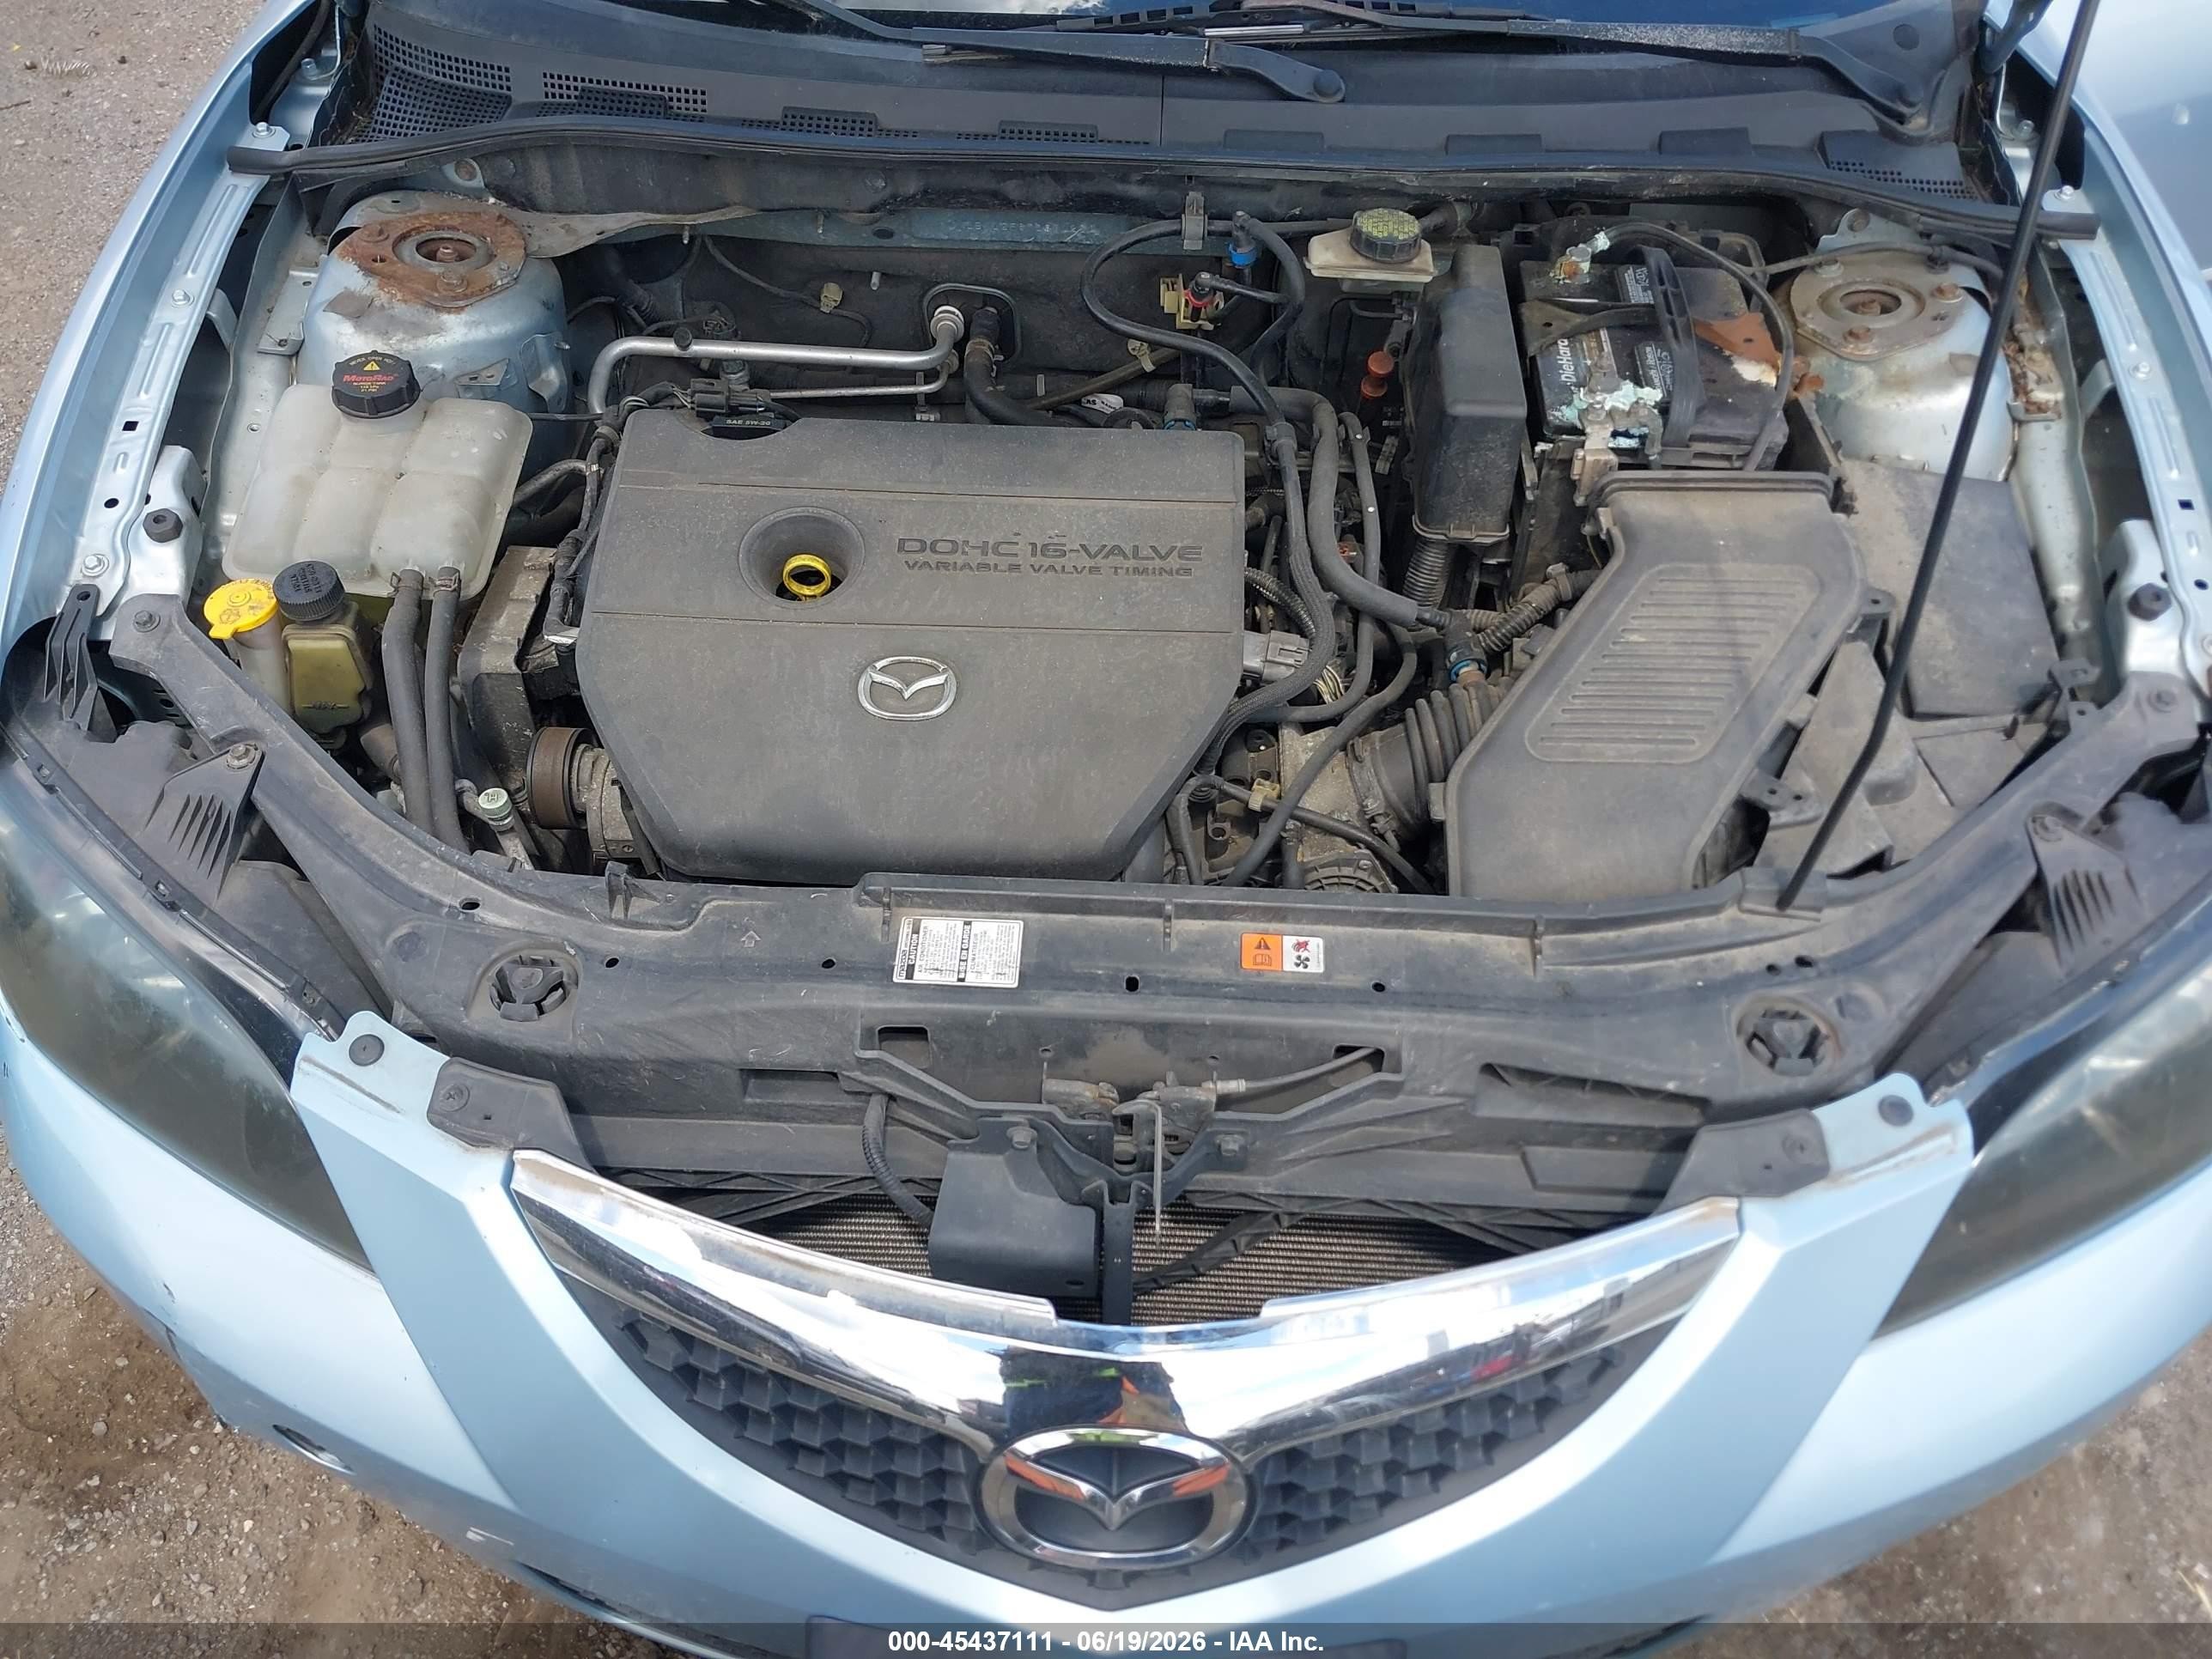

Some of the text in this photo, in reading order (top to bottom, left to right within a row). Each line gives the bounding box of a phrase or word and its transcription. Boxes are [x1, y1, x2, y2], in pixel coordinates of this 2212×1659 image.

[897, 538, 1203, 562] DOHC 16-VALVE
[904, 561, 1194, 577] VARIABLE VALVE TIMING
[908, 933, 920, 965] CAUTION
[919, 926, 928, 961] CONDITIONER
